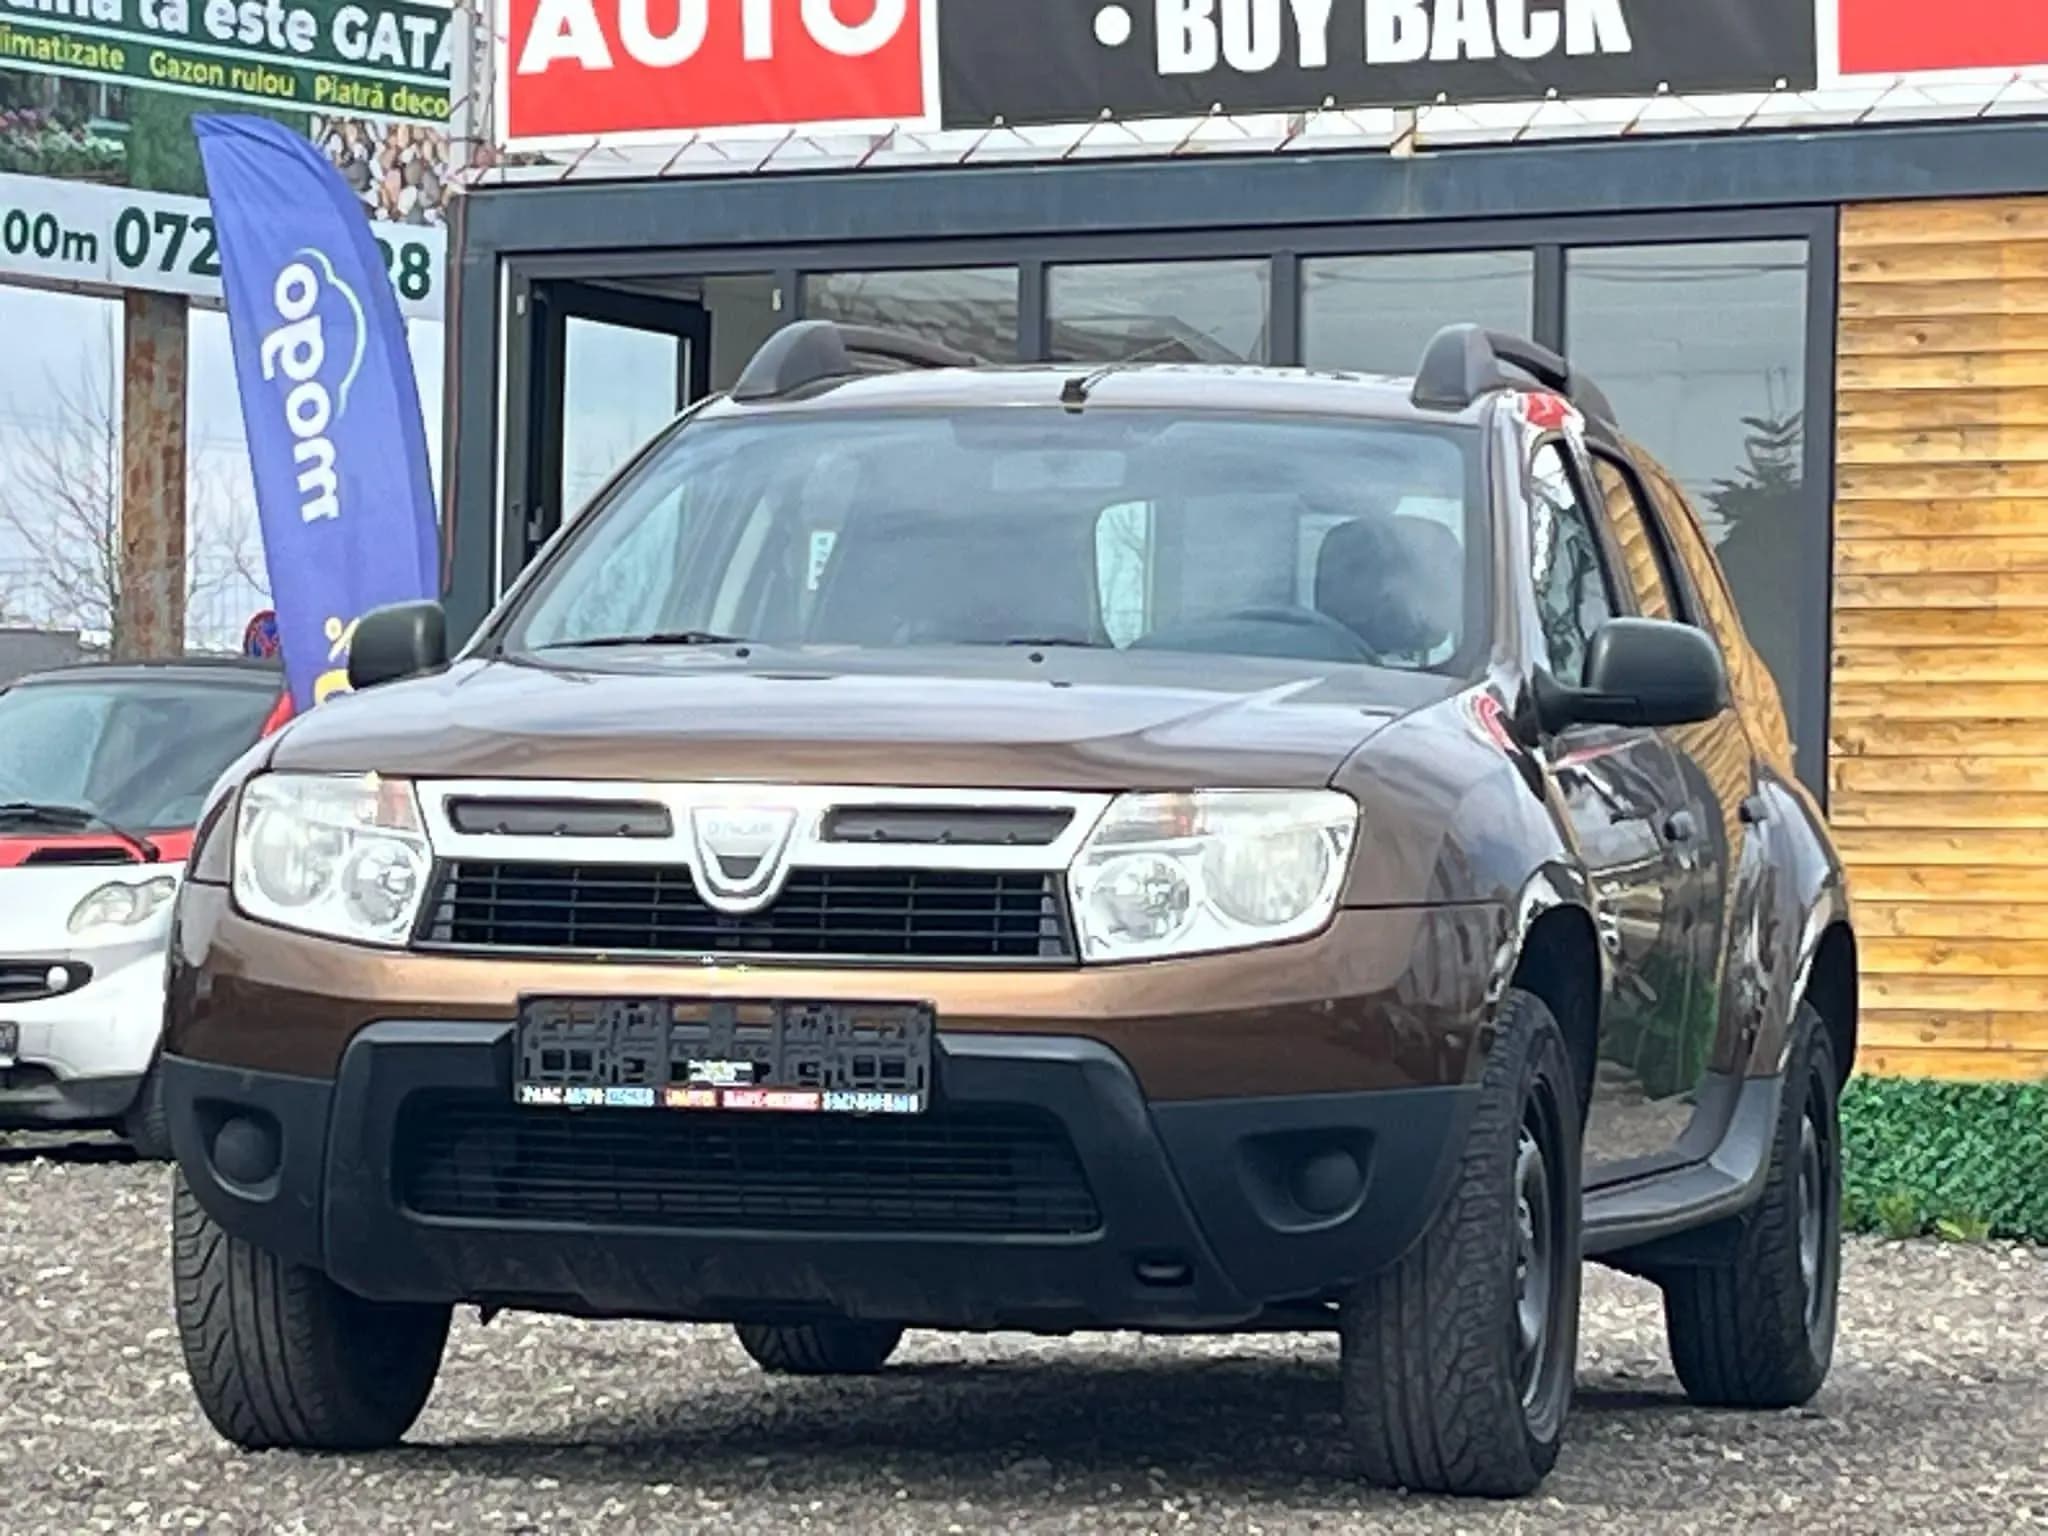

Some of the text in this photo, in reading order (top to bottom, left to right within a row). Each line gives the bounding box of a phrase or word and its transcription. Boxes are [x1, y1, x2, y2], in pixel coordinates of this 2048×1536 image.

[204, 0, 317, 52] este
[517, 0, 907, 74] AUTO
[1156, 0, 1632, 75] BUY BACK
[150, 50, 225, 86] Gazon
[232, 65, 296, 97] rulou
[391, 85, 450, 118] deco
[4, 209, 97, 264] 00m
